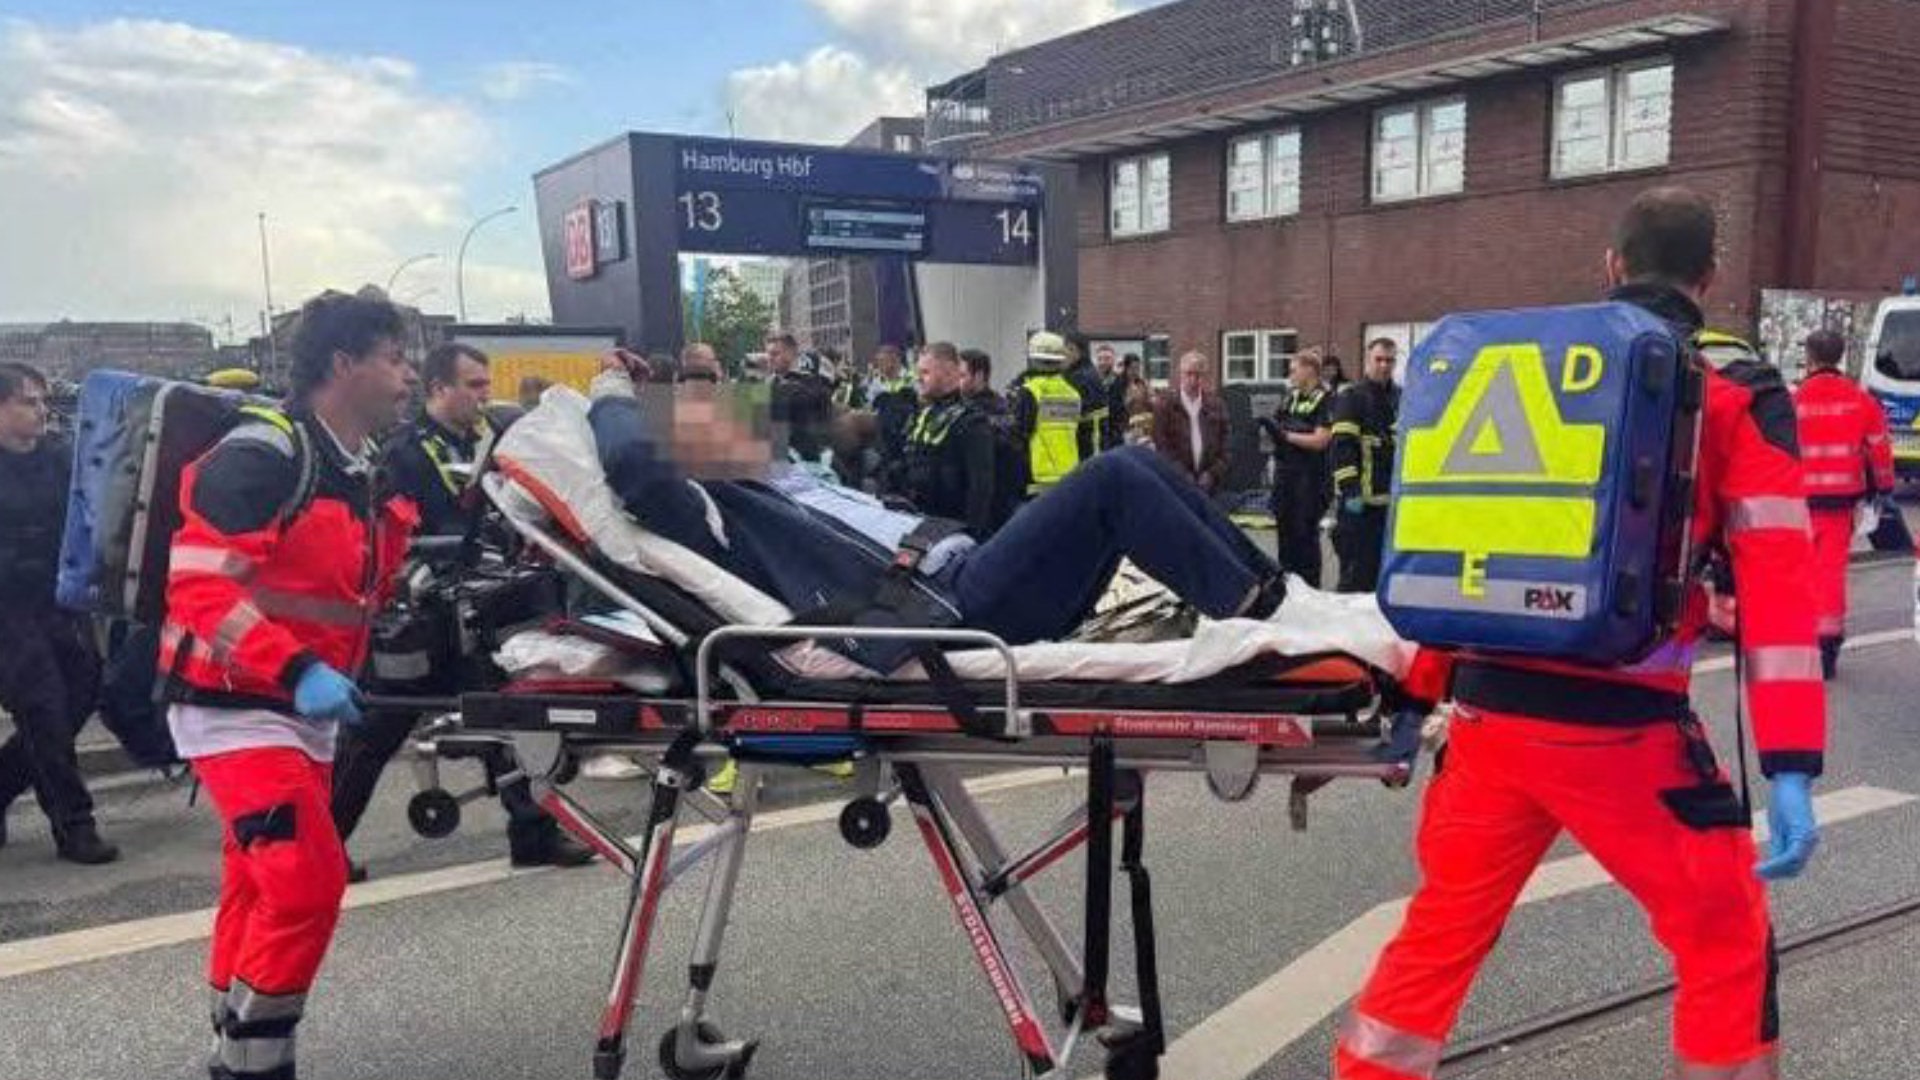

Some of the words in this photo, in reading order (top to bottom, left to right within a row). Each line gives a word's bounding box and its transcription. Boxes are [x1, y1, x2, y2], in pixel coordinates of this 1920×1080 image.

[682, 147, 773, 180] Hamburg
[777, 153, 814, 177] Hbf
[678, 190, 722, 231] 13
[994, 208, 1032, 246] 14
[1562, 344, 1603, 391] D
[1462, 550, 1488, 597] E
[1524, 585, 1575, 611] PAX
